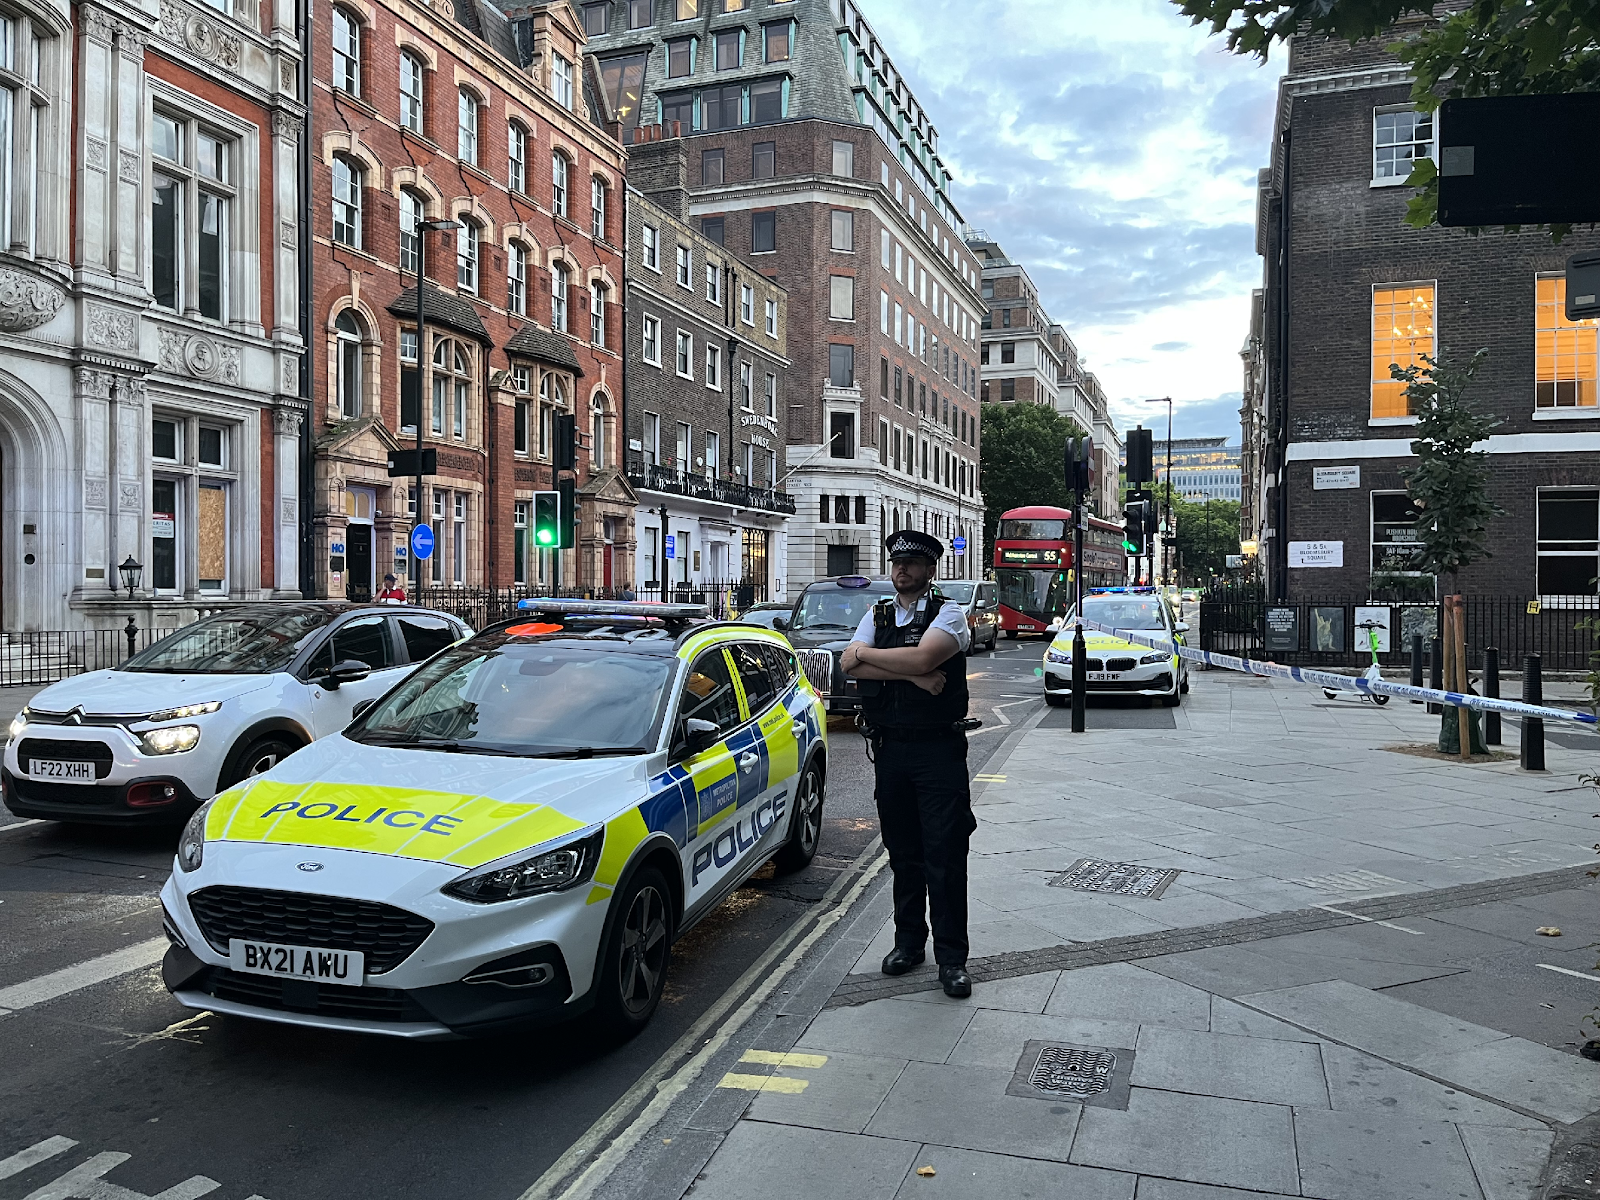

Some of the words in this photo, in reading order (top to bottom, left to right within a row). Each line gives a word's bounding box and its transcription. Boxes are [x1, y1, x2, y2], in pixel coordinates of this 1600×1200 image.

[741, 415, 778, 437] SWEDENBORG
[751, 434, 769, 448] HOUSE
[1528, 602, 1539, 613] H
[33, 760, 62, 776] LF22
[66, 764, 89, 778] XHH
[712, 778, 736, 797] METROPOLITAN
[716, 791, 734, 808] POLICE
[259, 801, 464, 837] POLICE
[692, 789, 788, 888] POLICE
[300, 862, 319, 872] Ford
[244, 944, 294, 973] BX21
[302, 950, 348, 979] AWU
